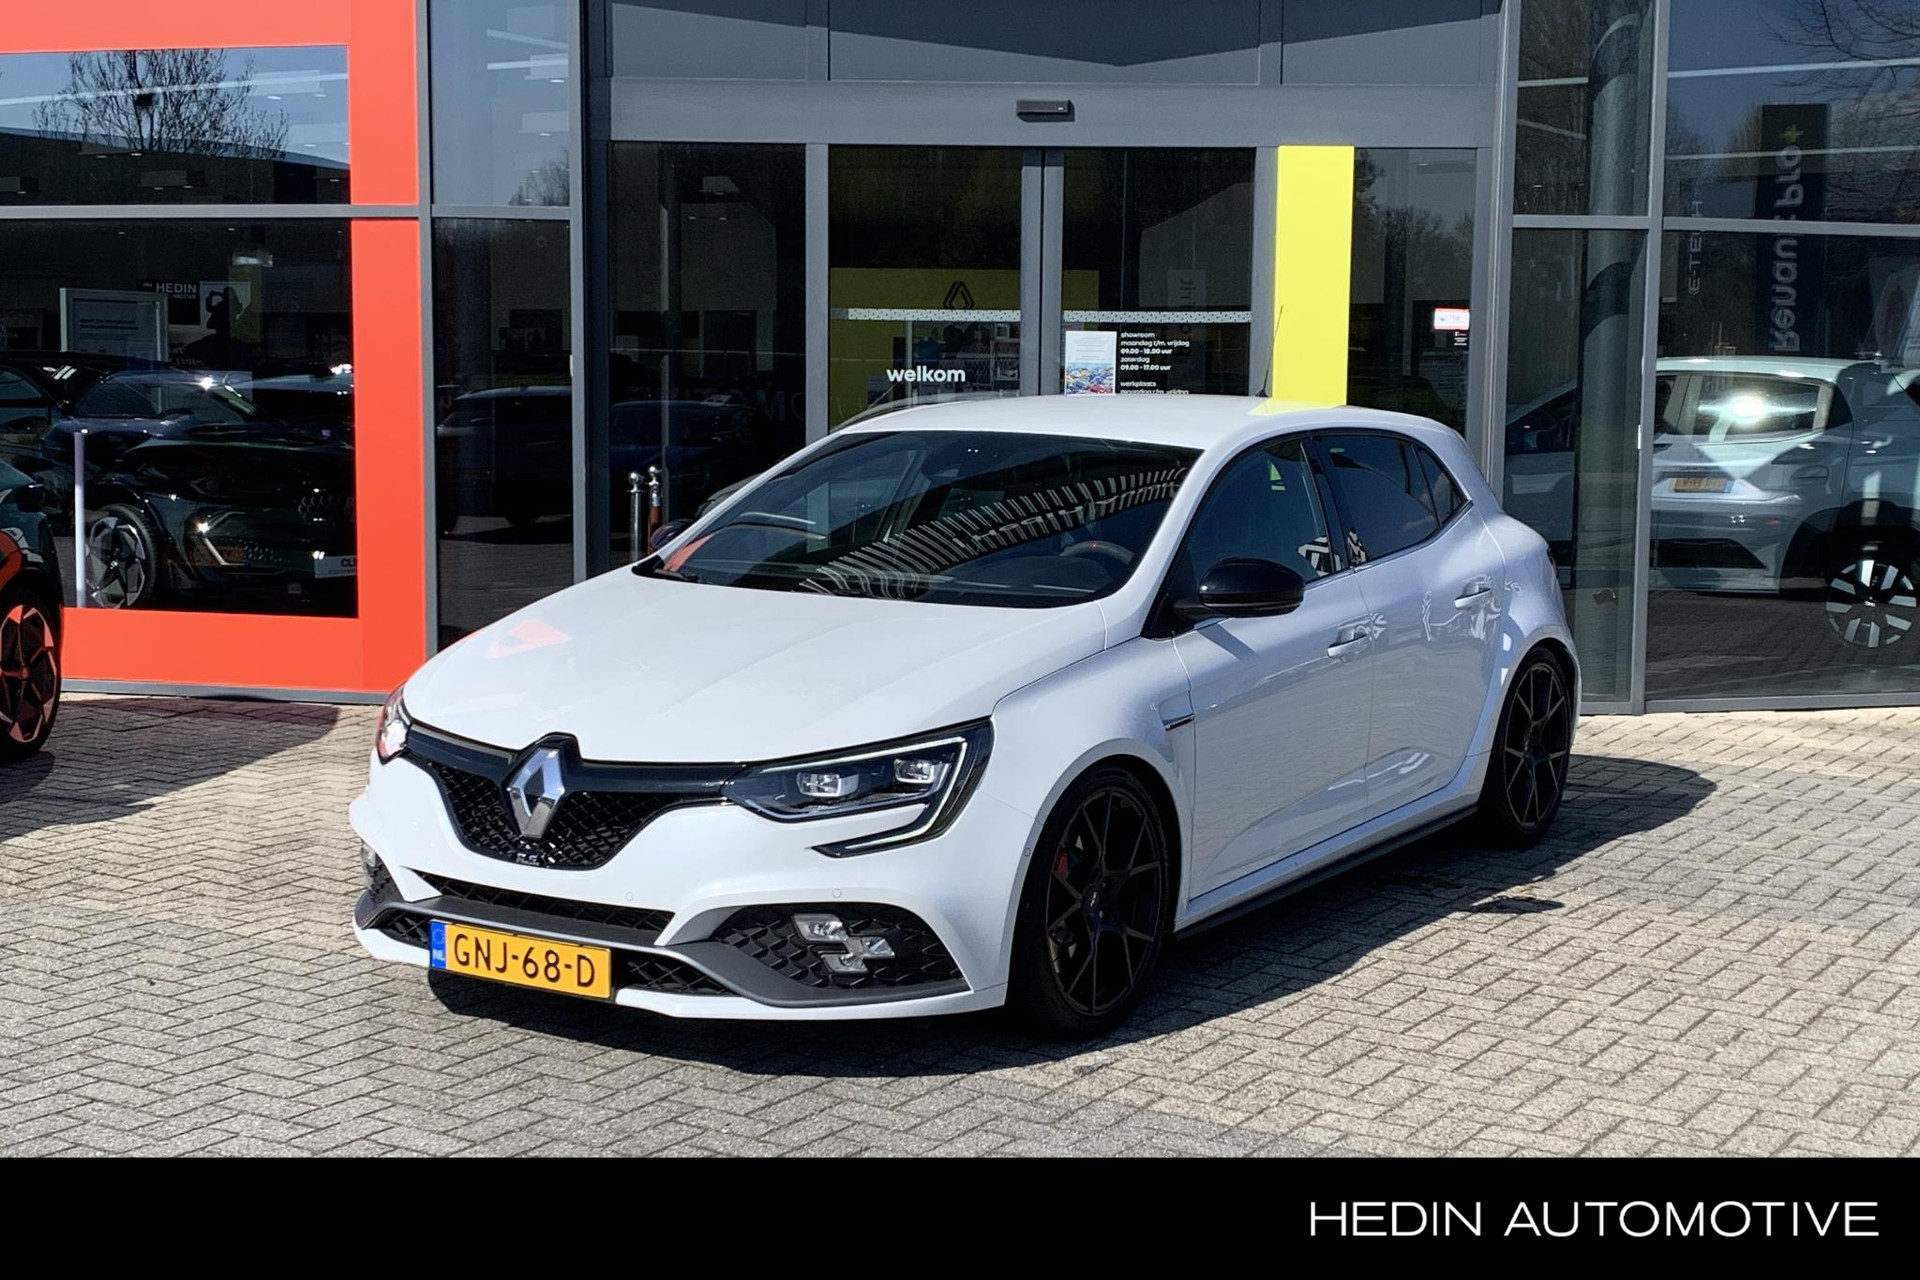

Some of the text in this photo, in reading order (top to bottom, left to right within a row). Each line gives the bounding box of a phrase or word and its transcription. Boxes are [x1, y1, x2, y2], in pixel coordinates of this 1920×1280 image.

[1688, 201, 1703, 296] E-TEH
[156, 283, 197, 294] HEDIN
[1121, 340, 1152, 348] maandag
[1167, 340, 1190, 348] vrijdag
[886, 365, 966, 382] welkom
[432, 949, 445, 961] NL
[454, 933, 595, 988] GNJ-68-D
